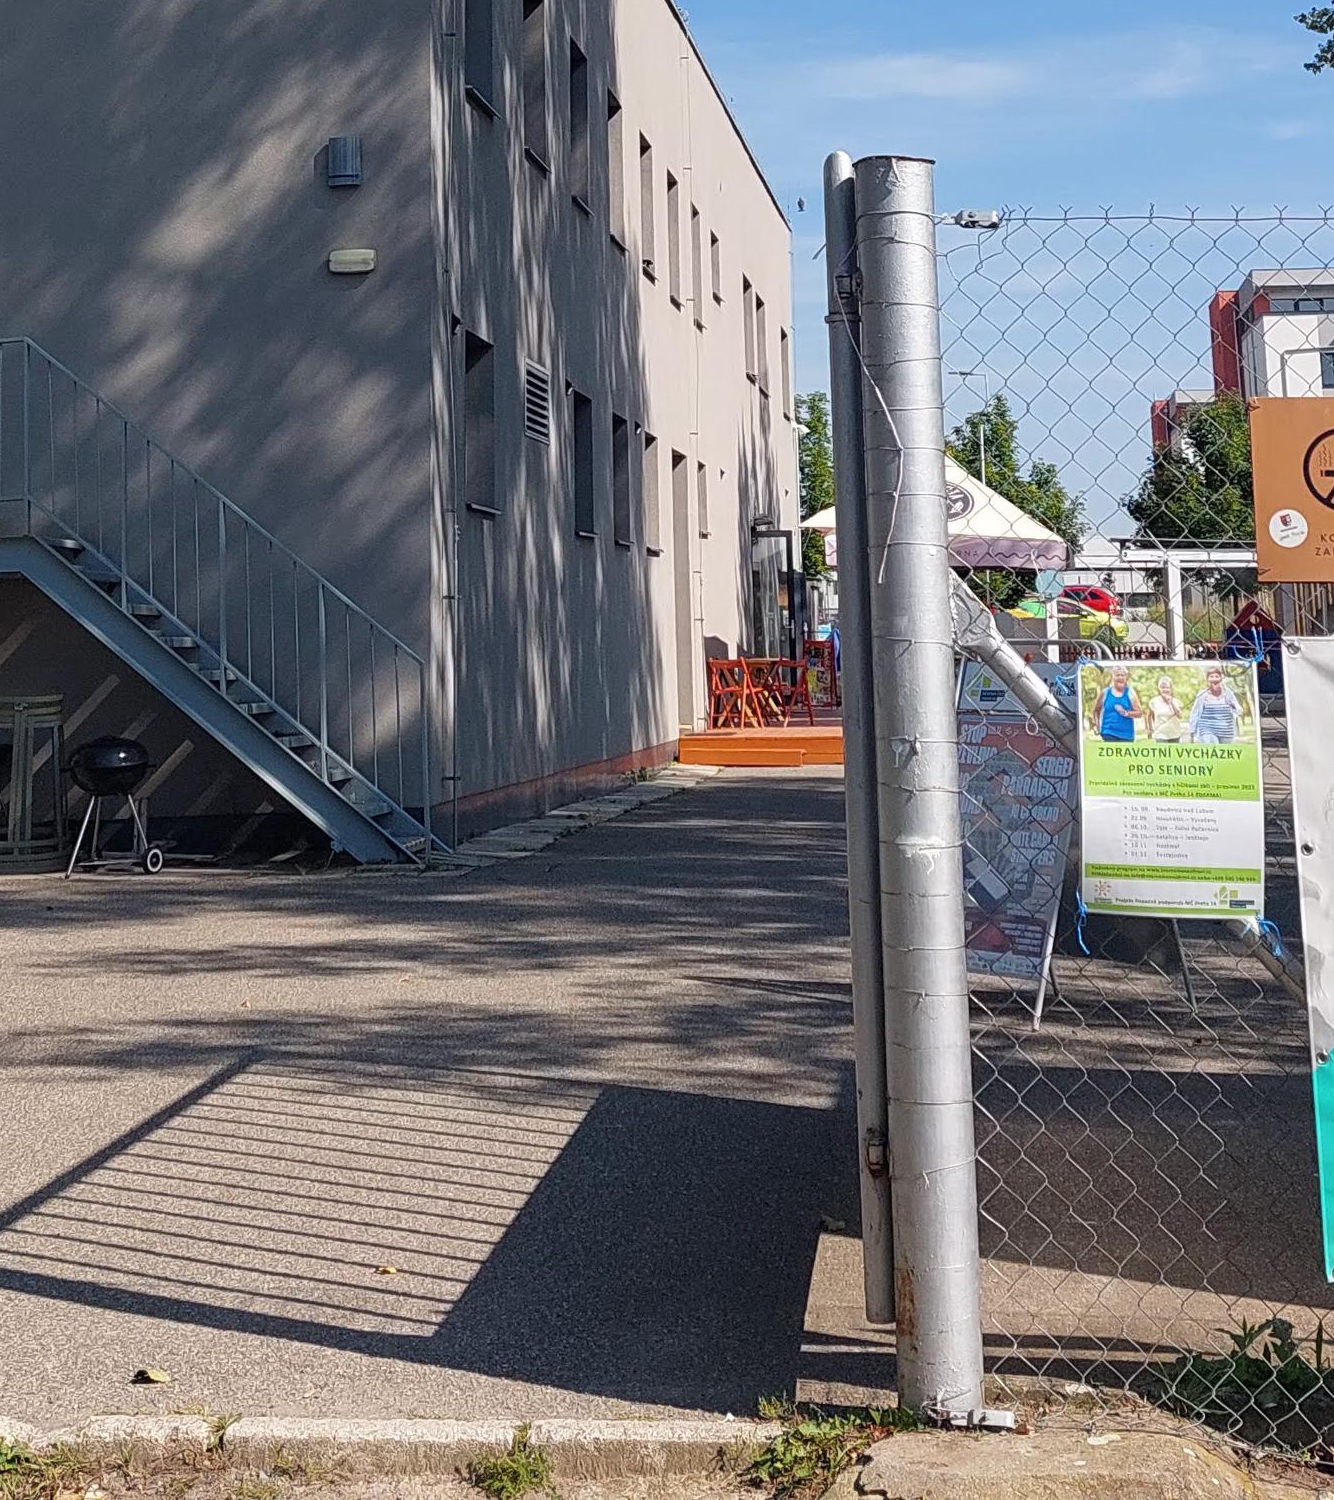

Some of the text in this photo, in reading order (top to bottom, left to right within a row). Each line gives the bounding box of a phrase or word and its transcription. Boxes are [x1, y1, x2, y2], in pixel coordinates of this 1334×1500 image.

[1098, 746, 1243, 760] ZDRAVOTNÍ VYCHÁZKY
[1128, 764, 1214, 776] PRO SENIORY
